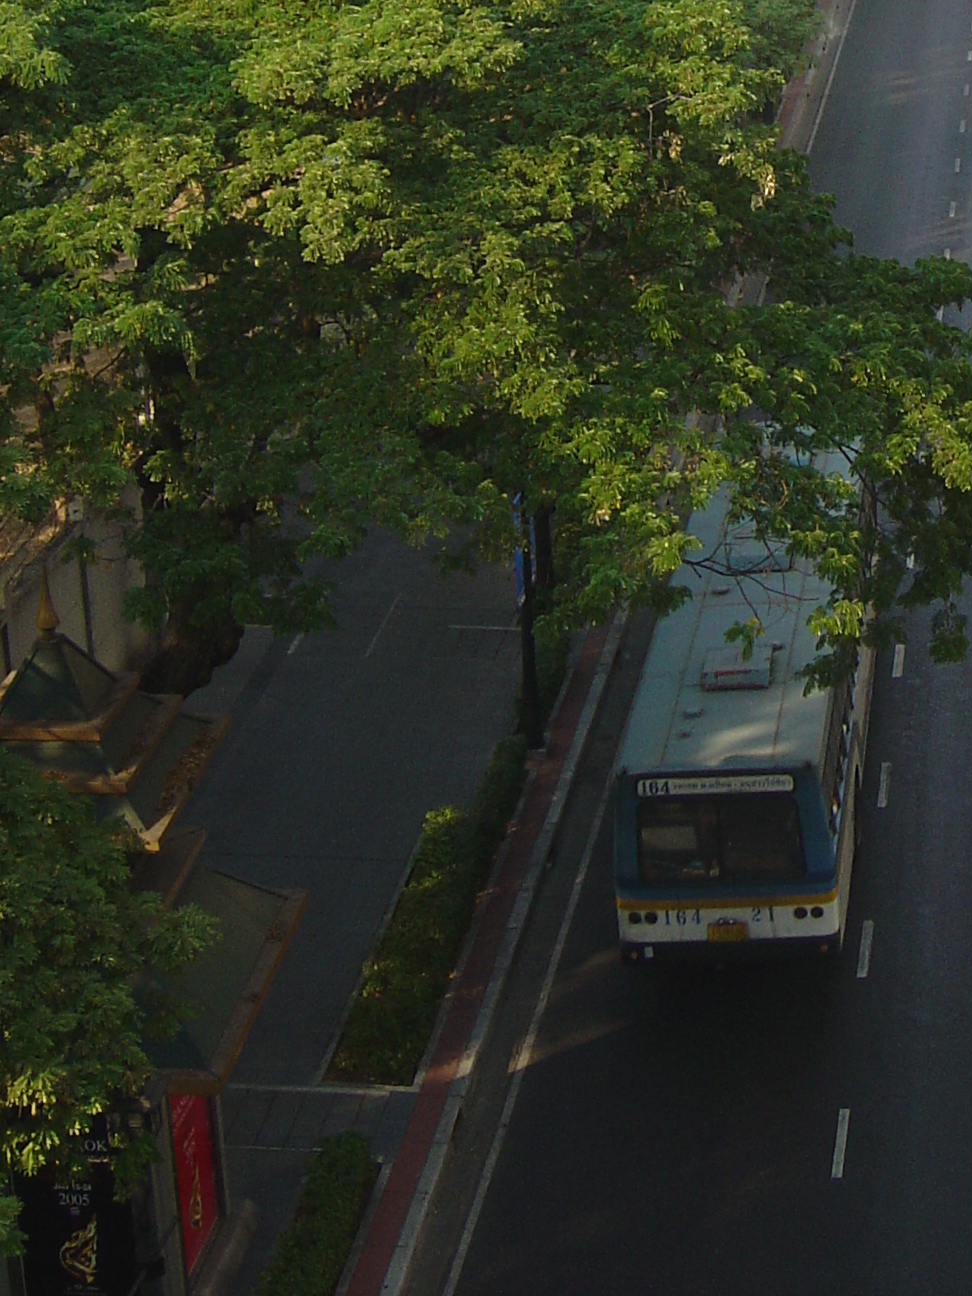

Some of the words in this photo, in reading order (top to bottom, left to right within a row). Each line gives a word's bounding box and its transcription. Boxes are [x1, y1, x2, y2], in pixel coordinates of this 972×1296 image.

[642, 779, 670, 796] 164
[665, 908, 701, 926] 164
[752, 906, 775, 923] 21
[58, 1193, 90, 1206] 2005
